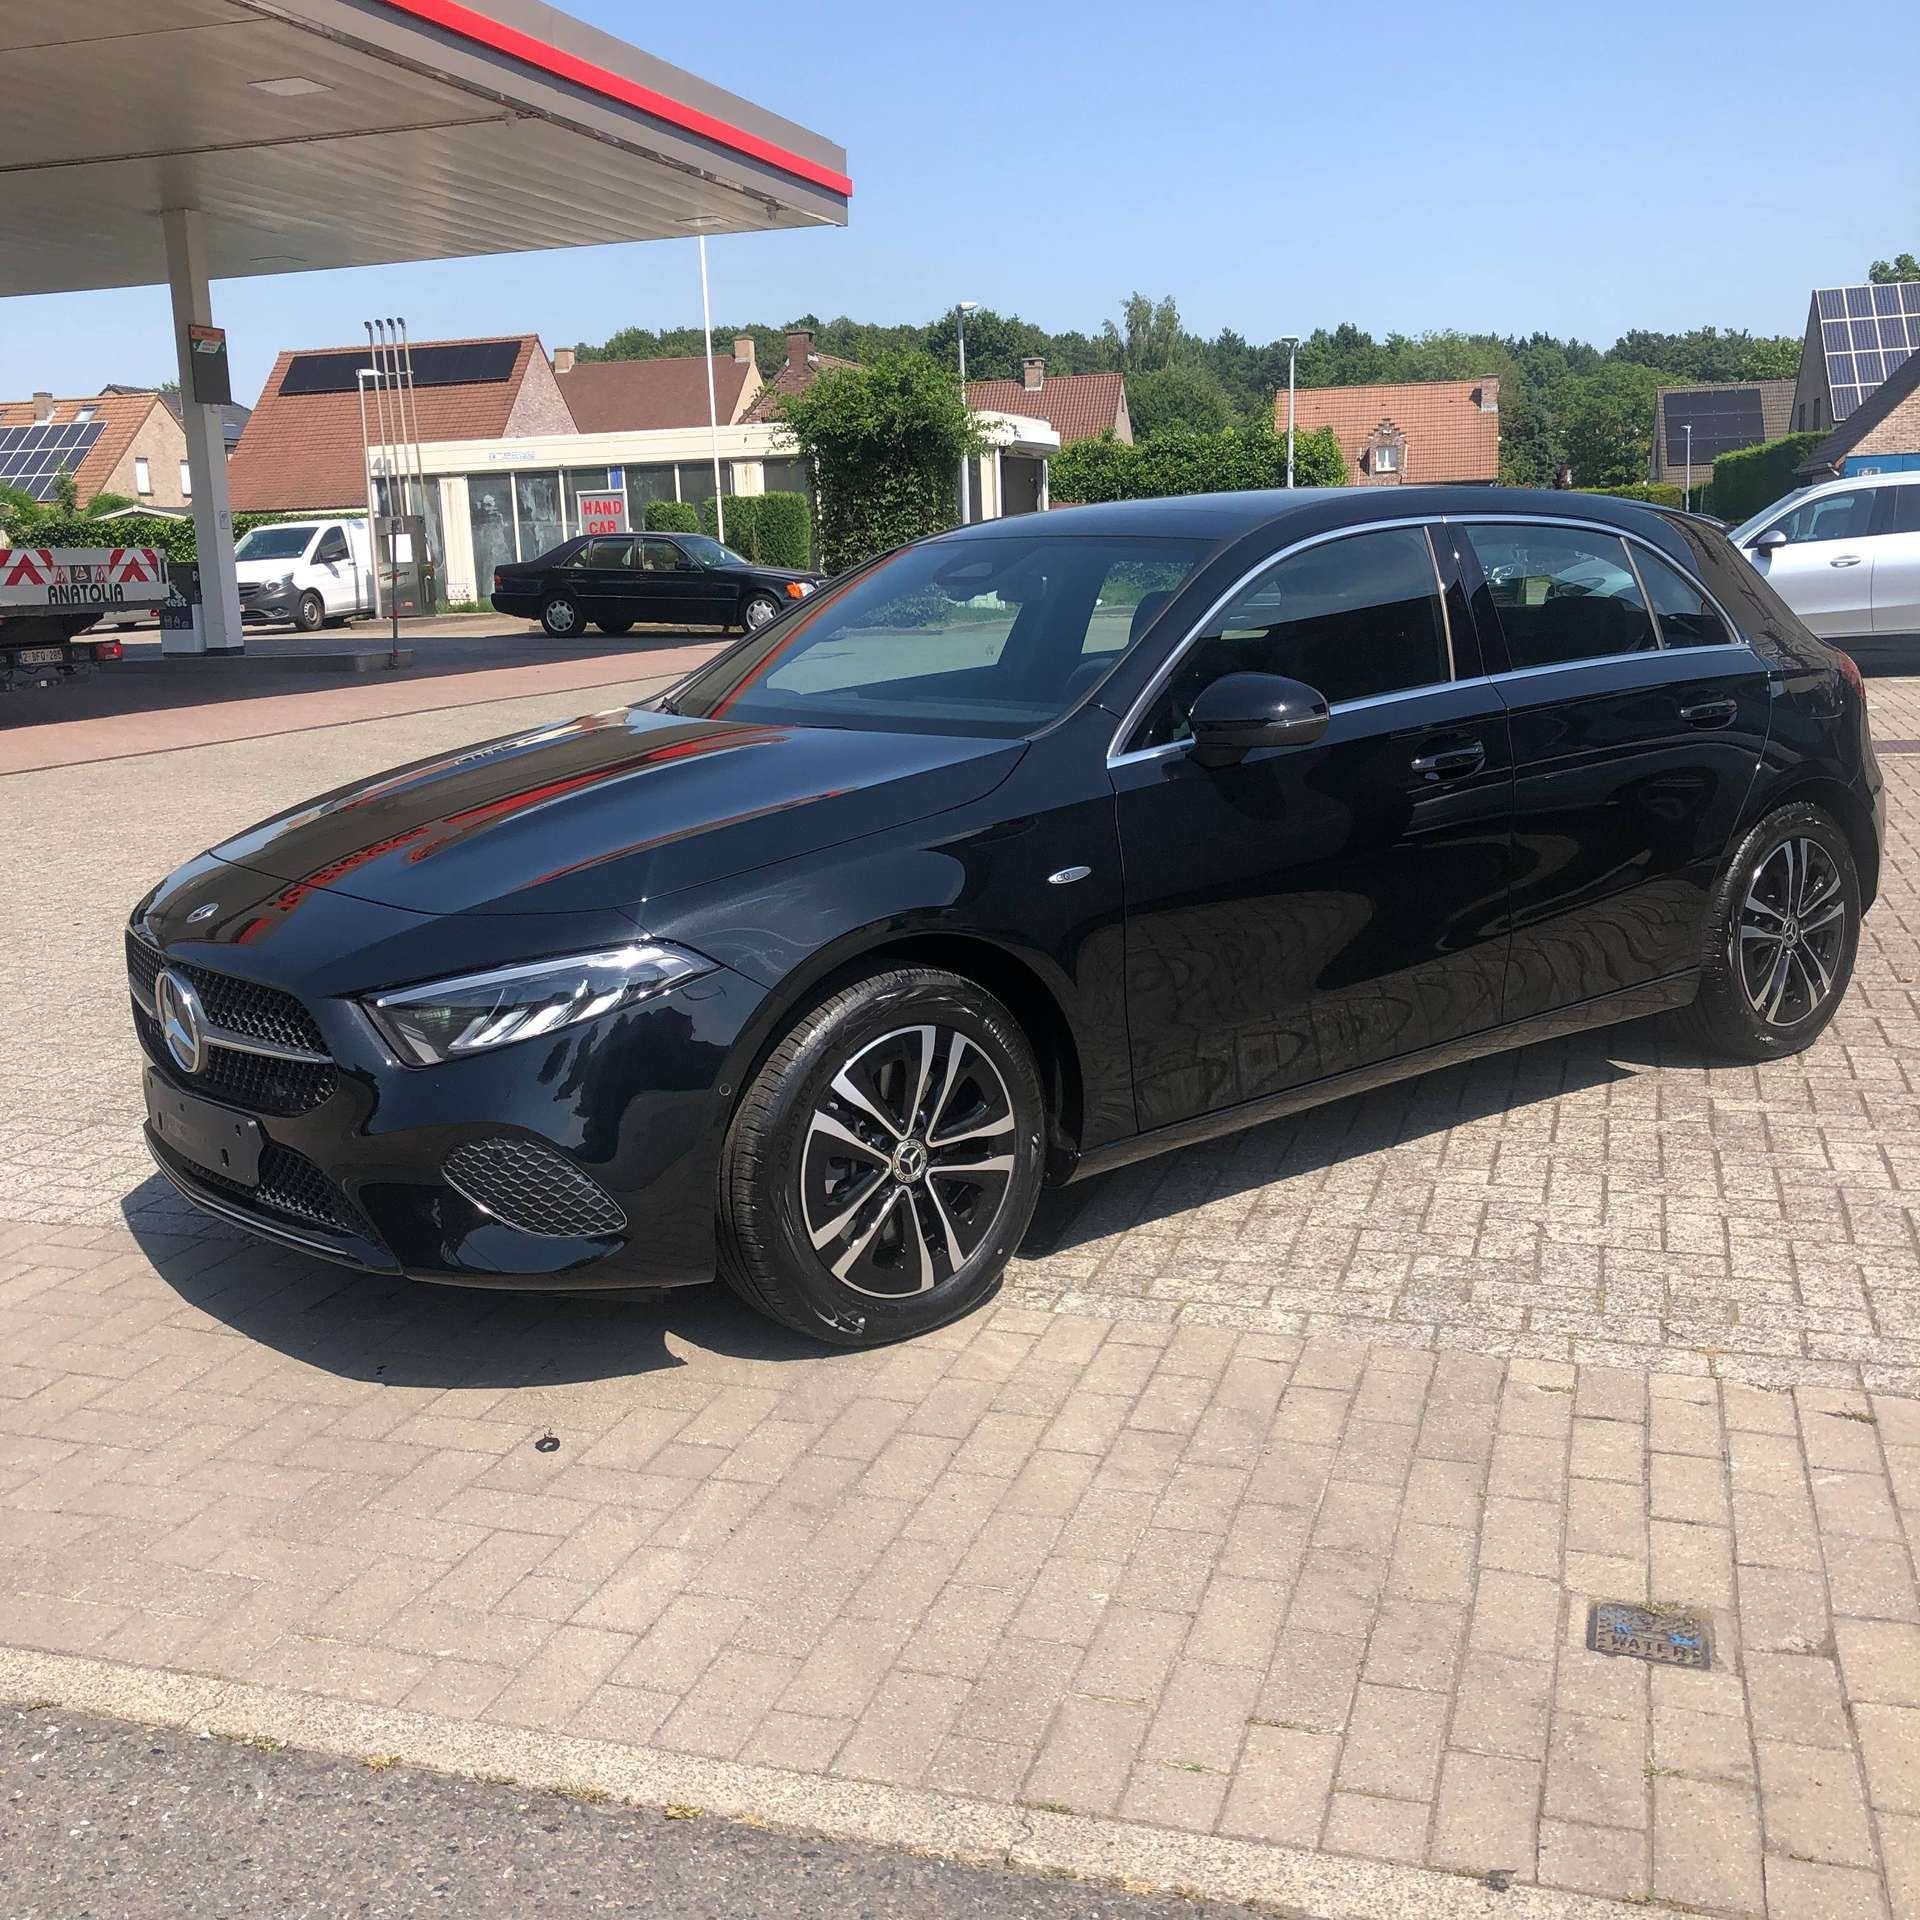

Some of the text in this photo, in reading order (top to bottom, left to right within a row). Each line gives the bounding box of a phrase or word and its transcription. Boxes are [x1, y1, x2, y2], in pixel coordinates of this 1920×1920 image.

[583, 500, 622, 515] HAND
[589, 520, 617, 534] CAR
[48, 583, 124, 605] ANATOLIA
